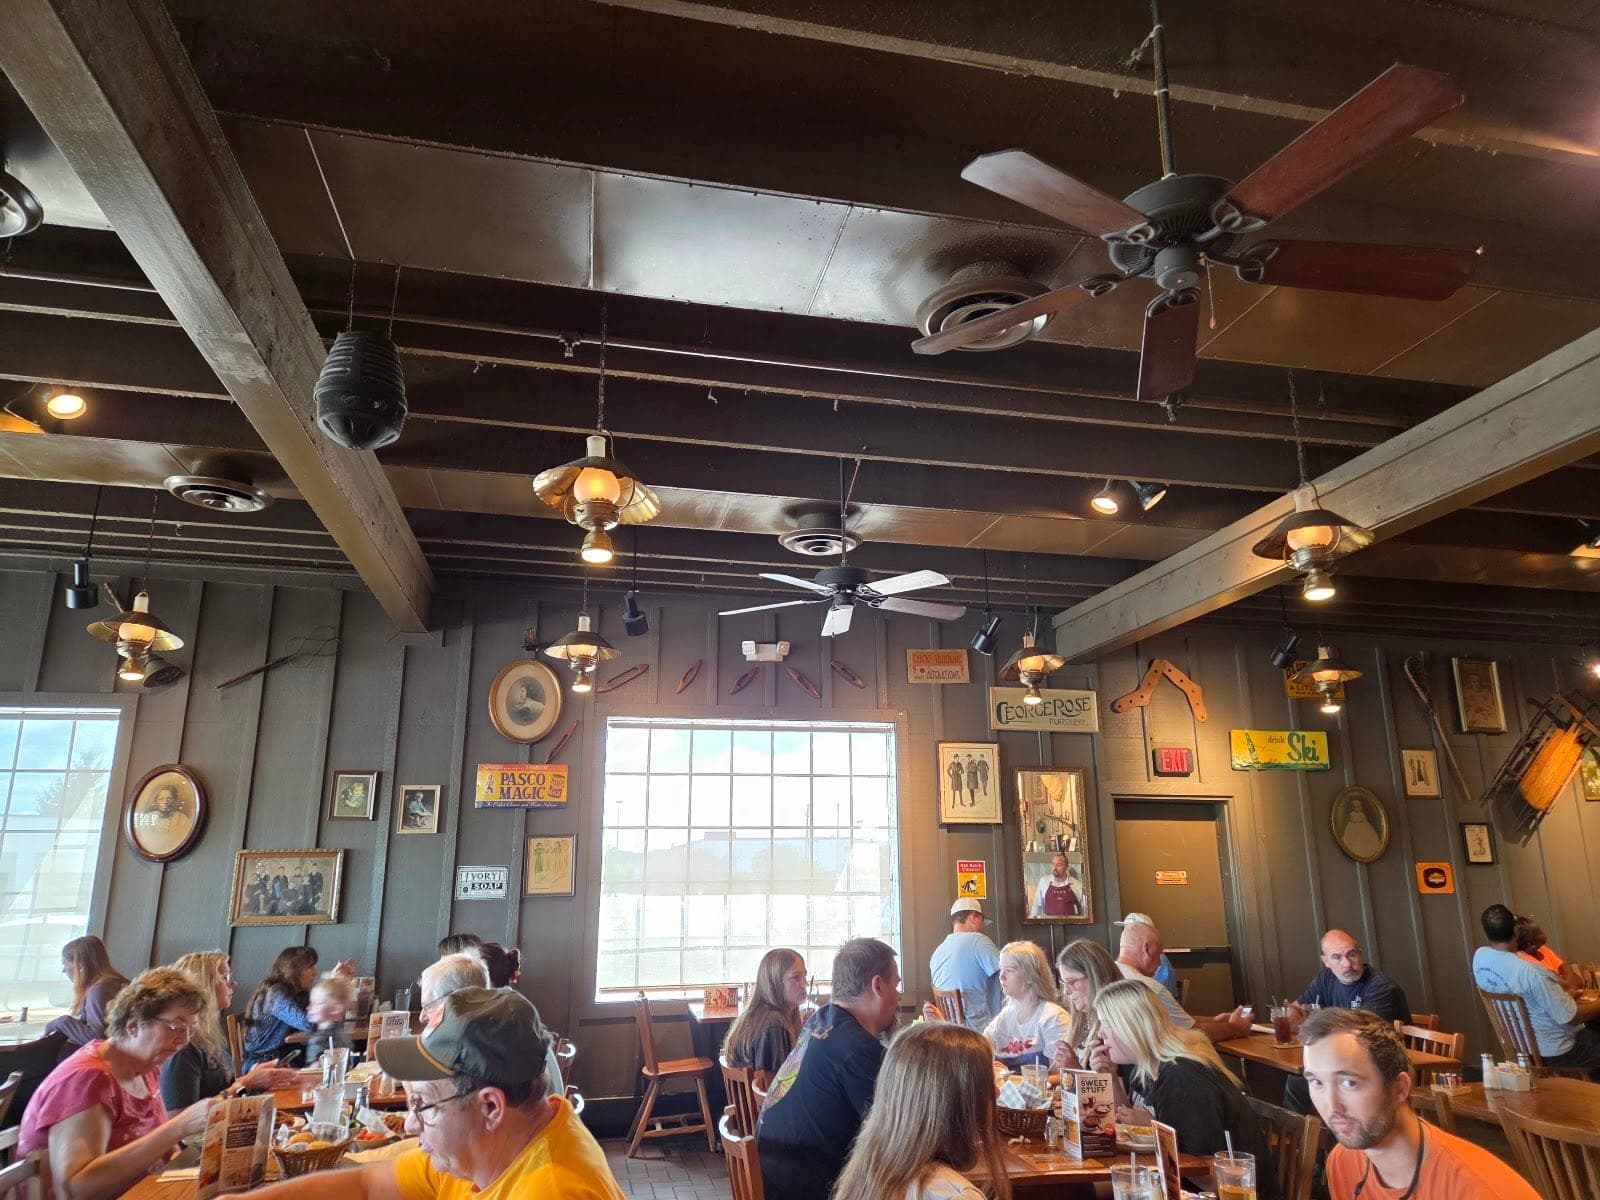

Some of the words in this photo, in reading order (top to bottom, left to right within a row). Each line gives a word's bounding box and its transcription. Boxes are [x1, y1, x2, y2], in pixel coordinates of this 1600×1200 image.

[1053, 697, 1092, 718] ROSE
[1267, 735, 1286, 744] drink
[1287, 732, 1320, 762] Ski
[1161, 748, 1188, 772] EXIT
[500, 772, 546, 786] PASCO
[499, 786, 546, 800] MAGIC
[472, 882, 503, 890] SOAP
[1080, 1079, 1108, 1087] SWEET
